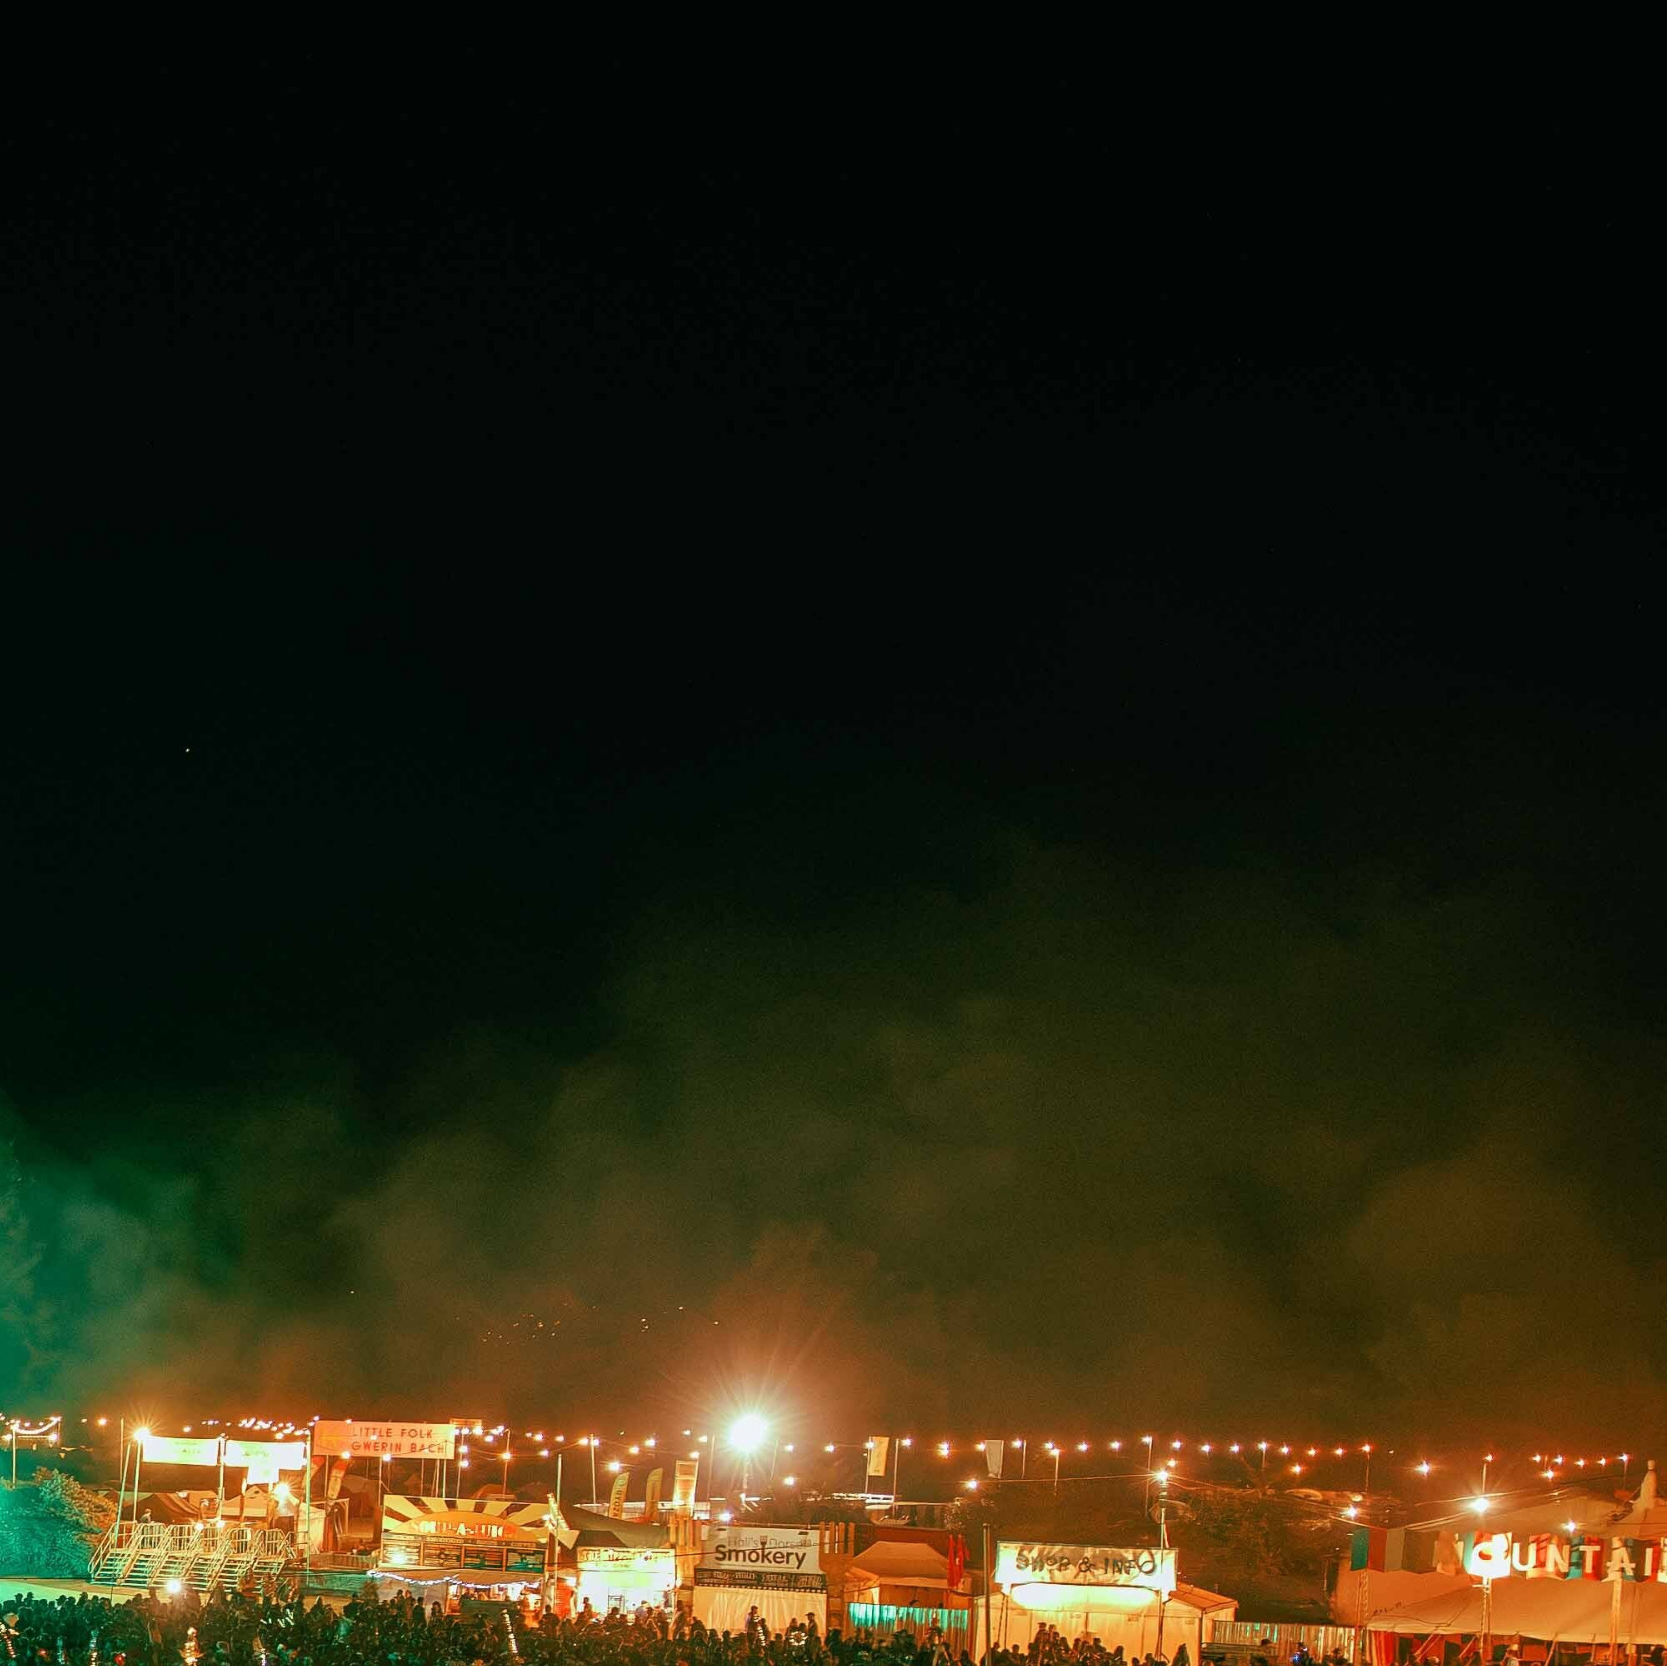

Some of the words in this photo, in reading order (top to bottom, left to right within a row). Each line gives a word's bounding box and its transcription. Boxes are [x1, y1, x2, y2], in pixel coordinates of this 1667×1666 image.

[353, 1427, 392, 1438] LITTLE
[401, 1428, 433, 1439] FOLK
[352, 1441, 401, 1453] GWERIN
[715, 1543, 806, 1569] Smokery
[1103, 1548, 1157, 1575] INFO
